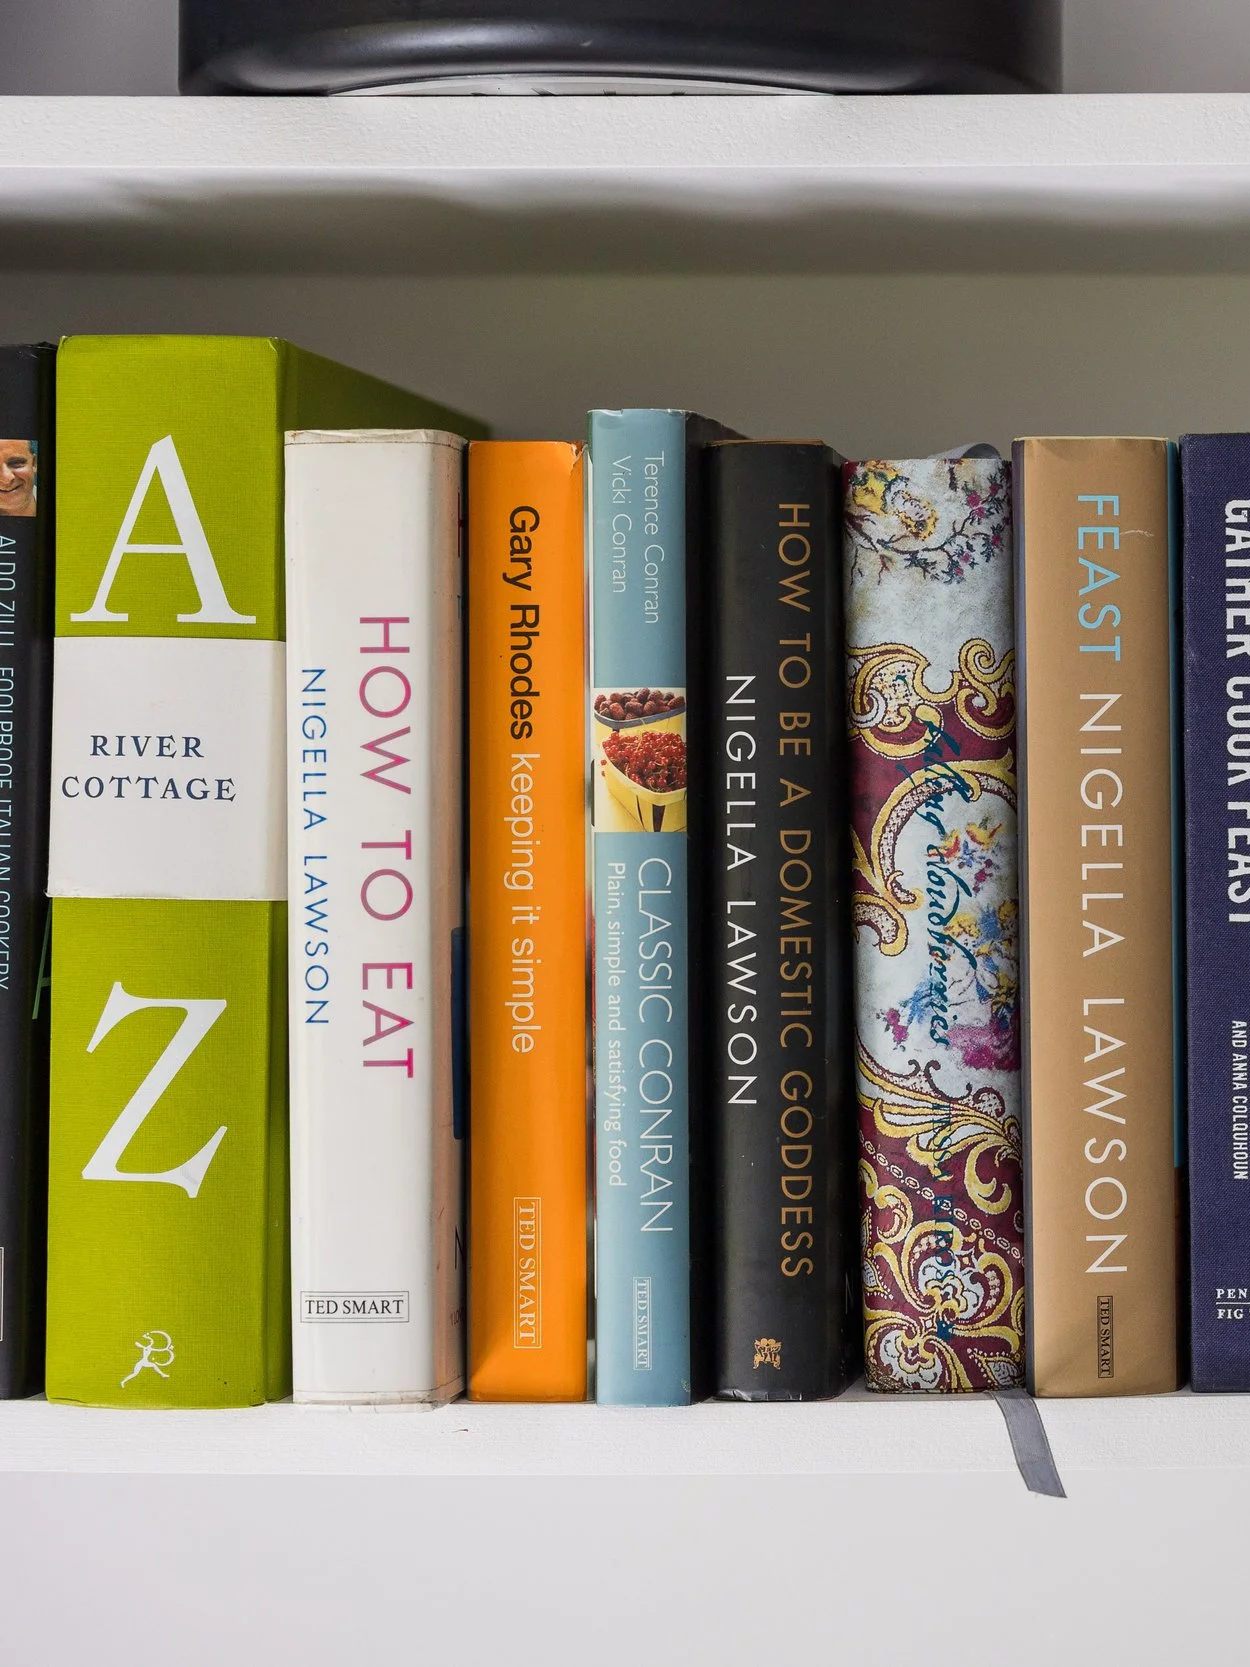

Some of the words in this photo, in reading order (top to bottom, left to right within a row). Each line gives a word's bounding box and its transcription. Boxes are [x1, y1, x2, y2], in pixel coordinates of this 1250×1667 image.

[612, 456, 631, 503] Vicki
[644, 451, 664, 535] Terence
[70, 435, 256, 624] A
[502, 506, 540, 591] Gary
[613, 514, 632, 592] Conran
[778, 504, 810, 611] HOW
[645, 545, 664, 623] Conran
[1077, 495, 1121, 661] FEAST
[510, 605, 539, 739] Rhodes
[779, 633, 810, 688] TO
[90, 735, 204, 758] RIVER
[359, 617, 411, 794] HOW
[780, 713, 810, 756] BE
[62, 776, 236, 801] COTTAGE
[302, 669, 327, 830] NIGELLA
[726, 676, 756, 870] NIGELLA
[504, 754, 540, 890] keeping
[780, 778, 811, 807] A
[1080, 694, 1125, 957] NIGELLA
[361, 830, 413, 921] TO
[512, 906, 541, 924] it
[603, 863, 626, 914] Plain,
[304, 856, 329, 1023] LAWSON
[603, 921, 625, 986] simple
[638, 858, 672, 1023] CLASSIC
[779, 829, 813, 1049] DOMESTIC
[363, 962, 414, 1078] EAT
[505, 938, 541, 1052] simple
[608, 995, 626, 1030] and
[727, 901, 757, 1104] LAWSON
[1232, 1021, 1247, 1047] AND
[82, 982, 227, 1198] Z
[604, 1040, 626, 1131] satisfying
[1233, 1053, 1247, 1090] ANNA
[608, 1139, 627, 1186] food
[639, 1039, 672, 1231] CONRAN
[779, 1071, 813, 1278] GODDESS
[931, 1103, 952, 1180] TESSA
[1083, 999, 1127, 1272] LAWSON
[1233, 1096, 1248, 1179] COLQUHOUN
[520, 1202, 535, 1250] TED
[936, 1194, 955, 1284] KIROS
[305, 1299, 338, 1315] TED
[342, 1299, 408, 1315] SMART
[520, 1258, 535, 1343] SMART
[637, 1280, 648, 1311] TED
[1100, 1299, 1110, 1326] TED
[1217, 1309, 1243, 1319] FIG
[637, 1314, 649, 1369] SMART
[1100, 1328, 1111, 1376] SMART
